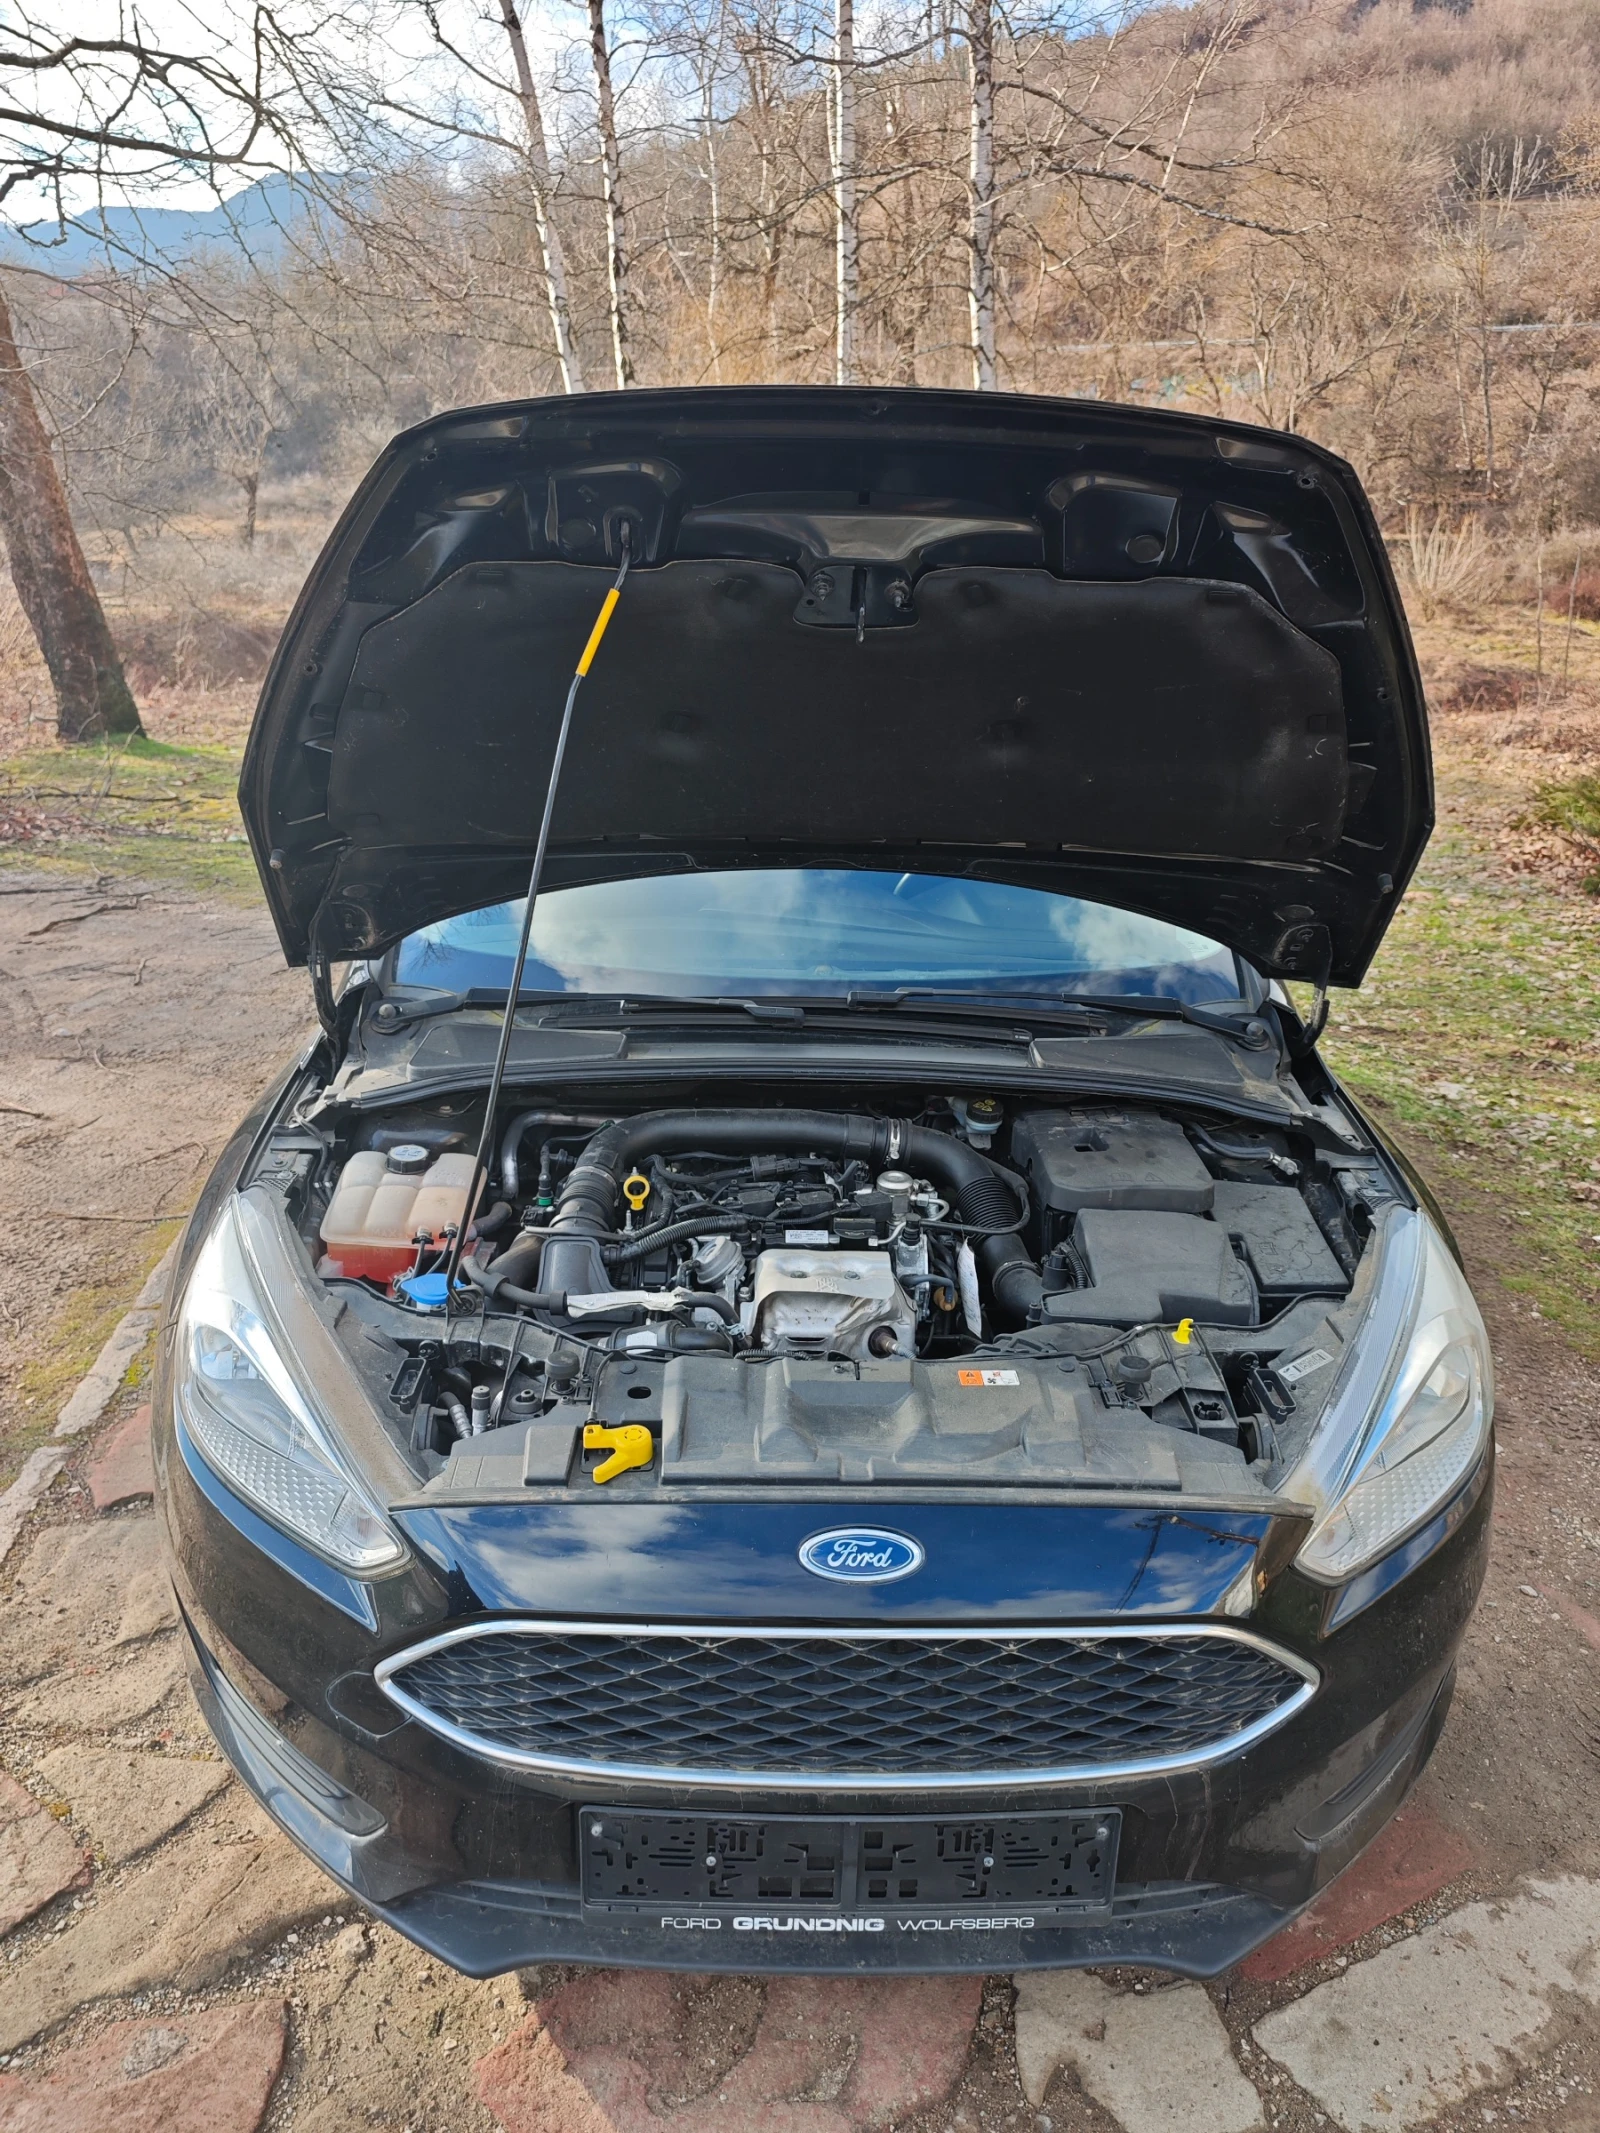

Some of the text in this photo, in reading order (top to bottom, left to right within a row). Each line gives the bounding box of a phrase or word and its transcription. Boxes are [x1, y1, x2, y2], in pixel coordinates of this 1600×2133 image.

[827, 1539, 893, 1568] Ford
[660, 1916, 1036, 1932] FORD GRUNDNIG WOLFSBERG
